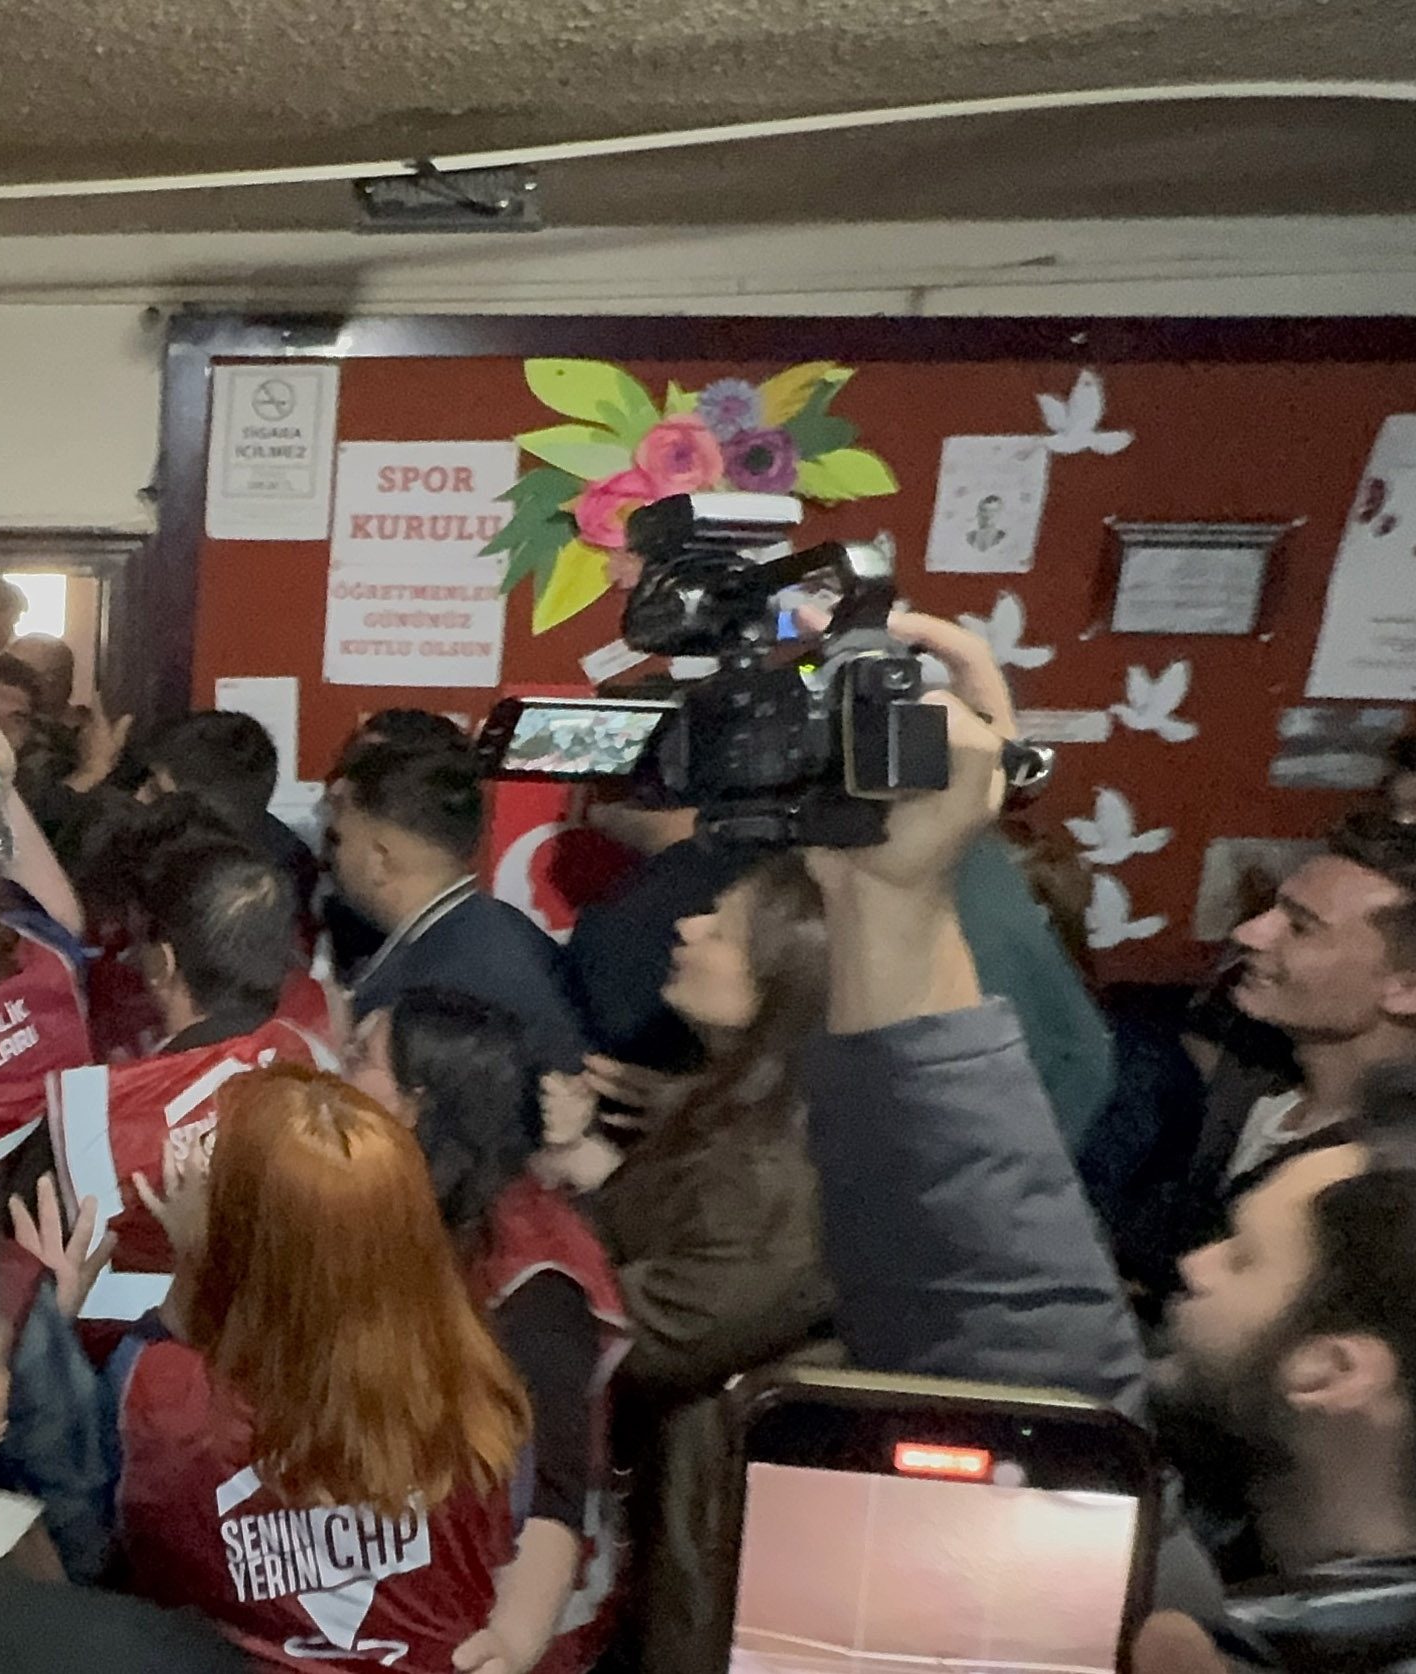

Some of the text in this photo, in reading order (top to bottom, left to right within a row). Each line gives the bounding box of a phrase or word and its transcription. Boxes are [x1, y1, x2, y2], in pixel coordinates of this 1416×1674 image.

[377, 465, 475, 494] SPOR
[349, 513, 503, 542] KURULU
[339, 638, 492, 657] KUTLU OLSUN
[324, 1505, 418, 1571] CHP
